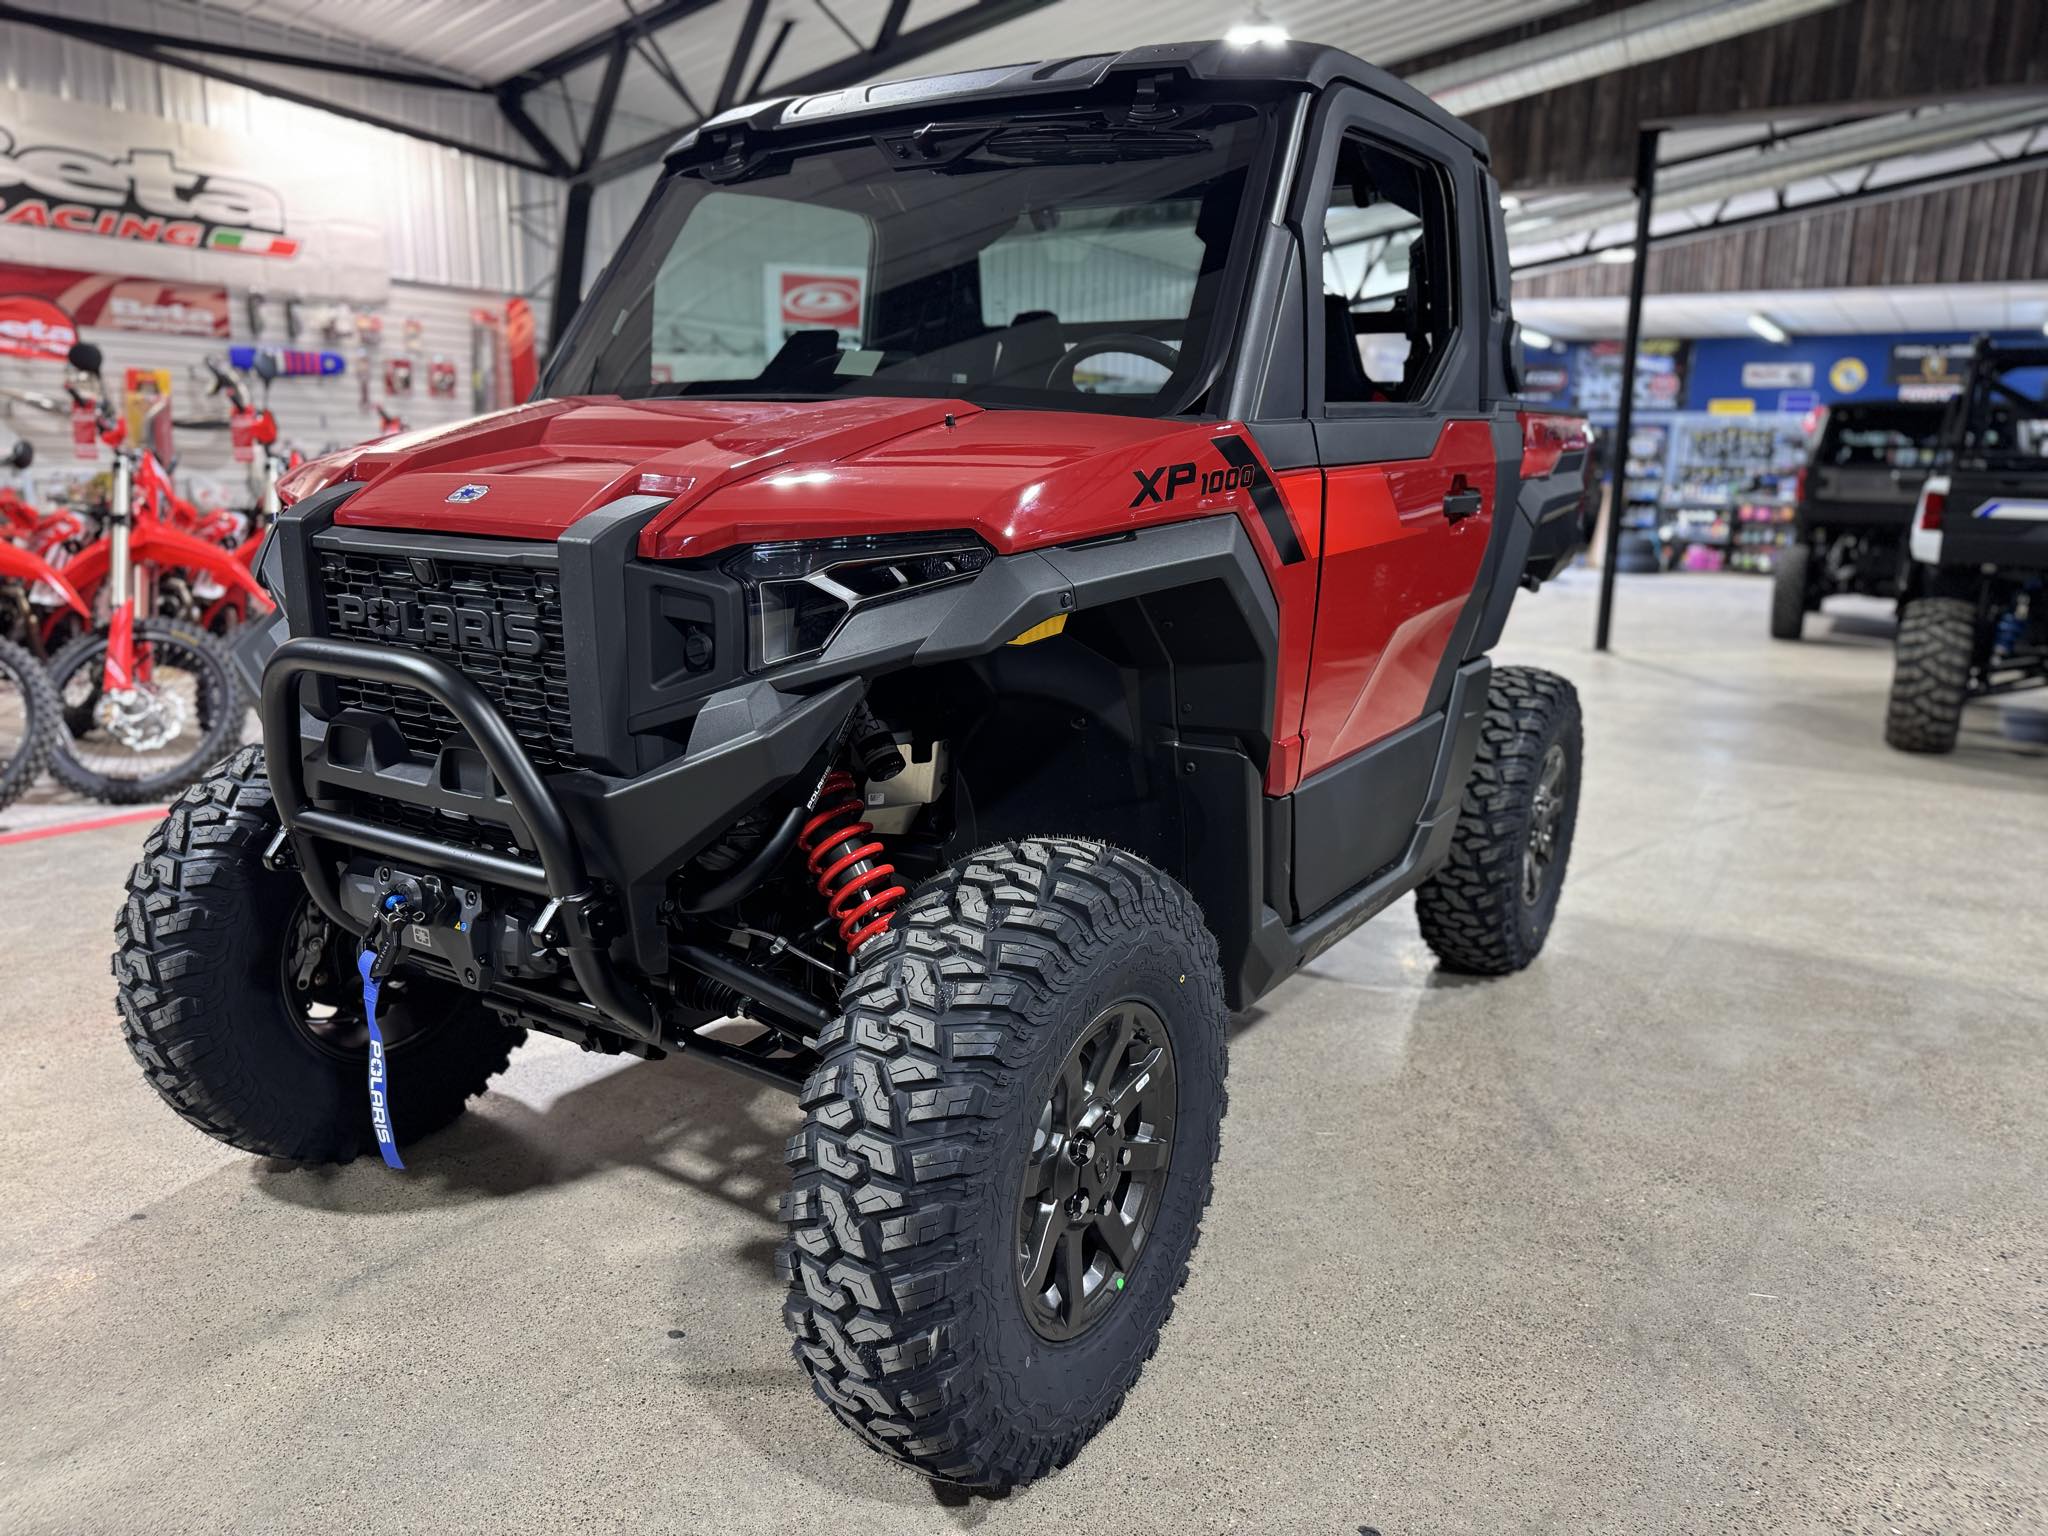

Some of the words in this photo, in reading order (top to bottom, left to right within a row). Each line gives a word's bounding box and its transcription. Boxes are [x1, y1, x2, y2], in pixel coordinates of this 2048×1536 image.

[0, 197, 203, 248] ACING
[0, 319, 76, 344] eta
[1129, 462, 1196, 508] XP
[1201, 464, 1255, 495] 1000
[336, 593, 543, 655] POLARIS
[806, 765, 833, 811] POLARIS
[370, 1039, 391, 1144] POLARIS
